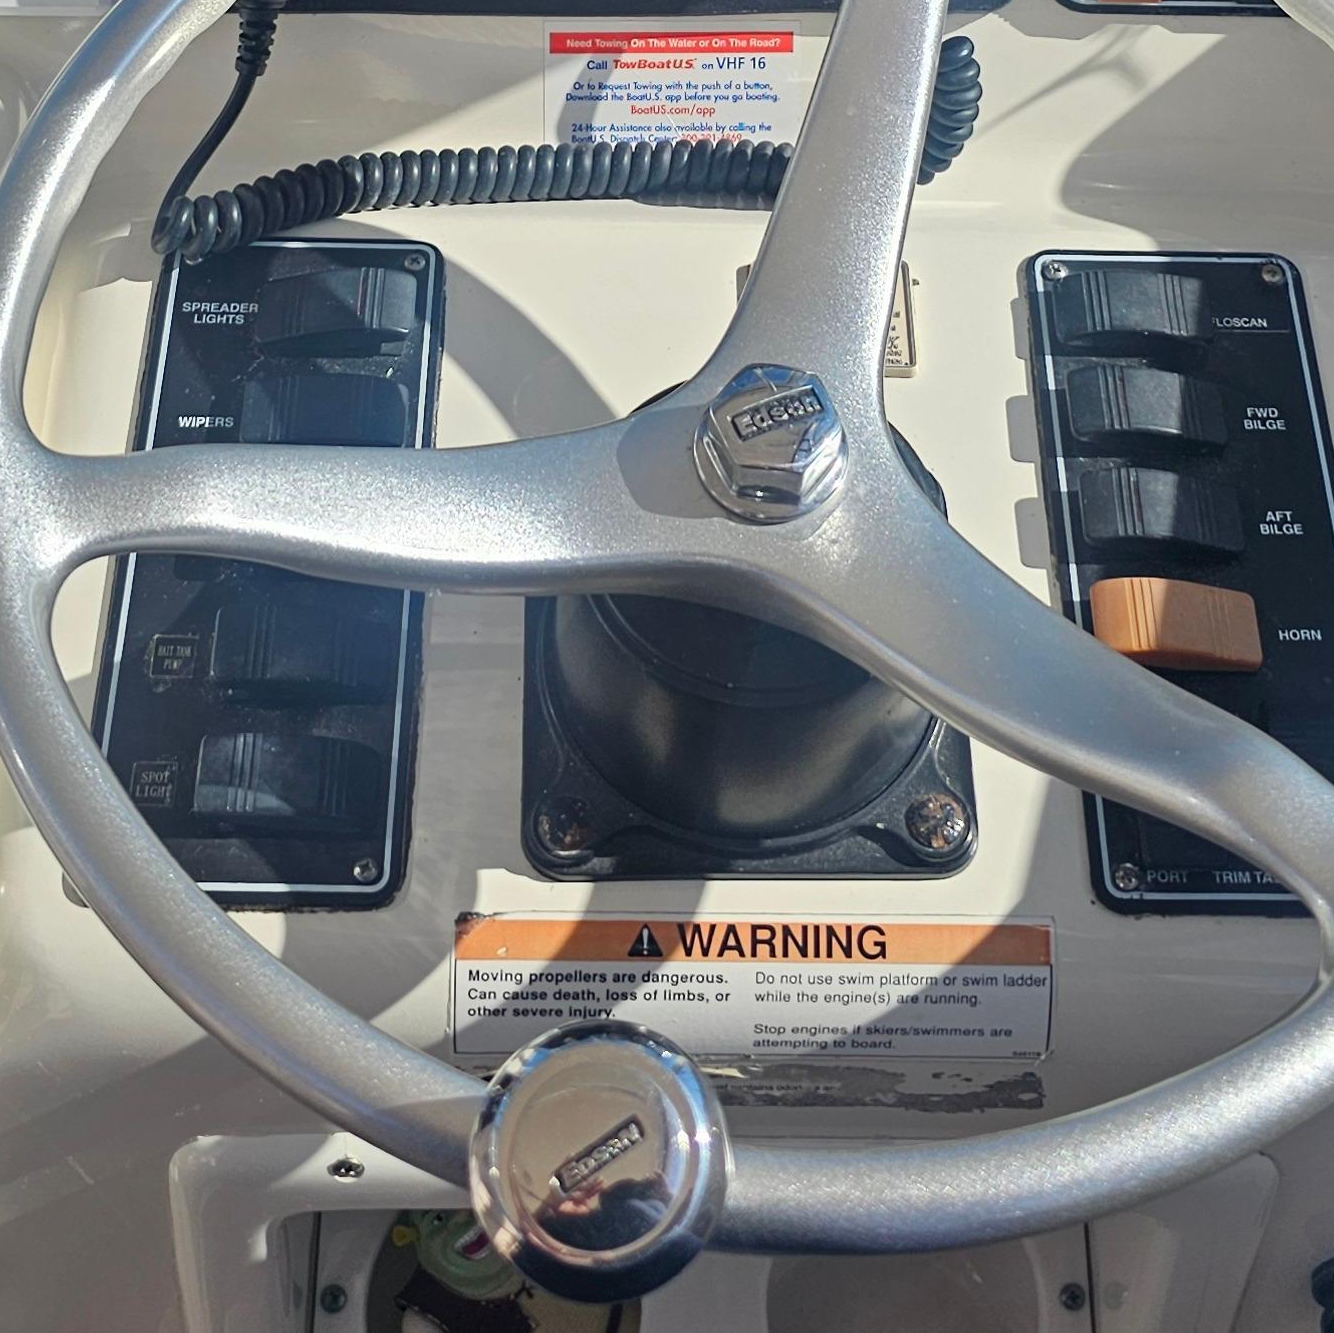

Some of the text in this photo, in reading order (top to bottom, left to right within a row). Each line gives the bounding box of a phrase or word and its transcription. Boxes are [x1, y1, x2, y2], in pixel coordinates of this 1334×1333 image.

[567, 39, 593, 47] Need
[595, 39, 628, 49] Towing
[631, 39, 645, 47] On
[648, 39, 666, 47] The
[669, 39, 696, 47] Water
[712, 39, 725, 47] On
[729, 39, 747, 47] The
[749, 38, 780, 47] Road?
[587, 60, 607, 70] Call
[716, 57, 745, 69] VHF
[750, 57, 766, 69] 16
[631, 105, 715, 117] BoatUS.com/app
[182, 302, 258, 313] SPREADER
[194, 314, 244, 325] LIGHTS
[1247, 407, 1278, 418] FWD
[178, 417, 234, 428] WIPERS
[1244, 419, 1286, 430] BILGE
[1266, 511, 1292, 522] AFT
[1259, 524, 1303, 535] BILGE
[1279, 629, 1322, 642] HORN
[141, 771, 169, 783] SPOT
[1147, 871, 1252, 884] PORT TRIM
[676, 923, 887, 960] WARNING
[468, 969, 728, 987] Moving propellers are dangerous.
[755, 972, 1047, 989] Do not use swim platform or swim ladder
[468, 989, 731, 1003] Can cause death, loss of limbs, or
[755, 991, 981, 1007] while the engine(s) are running.
[468, 1006, 615, 1020] other severe injury.
